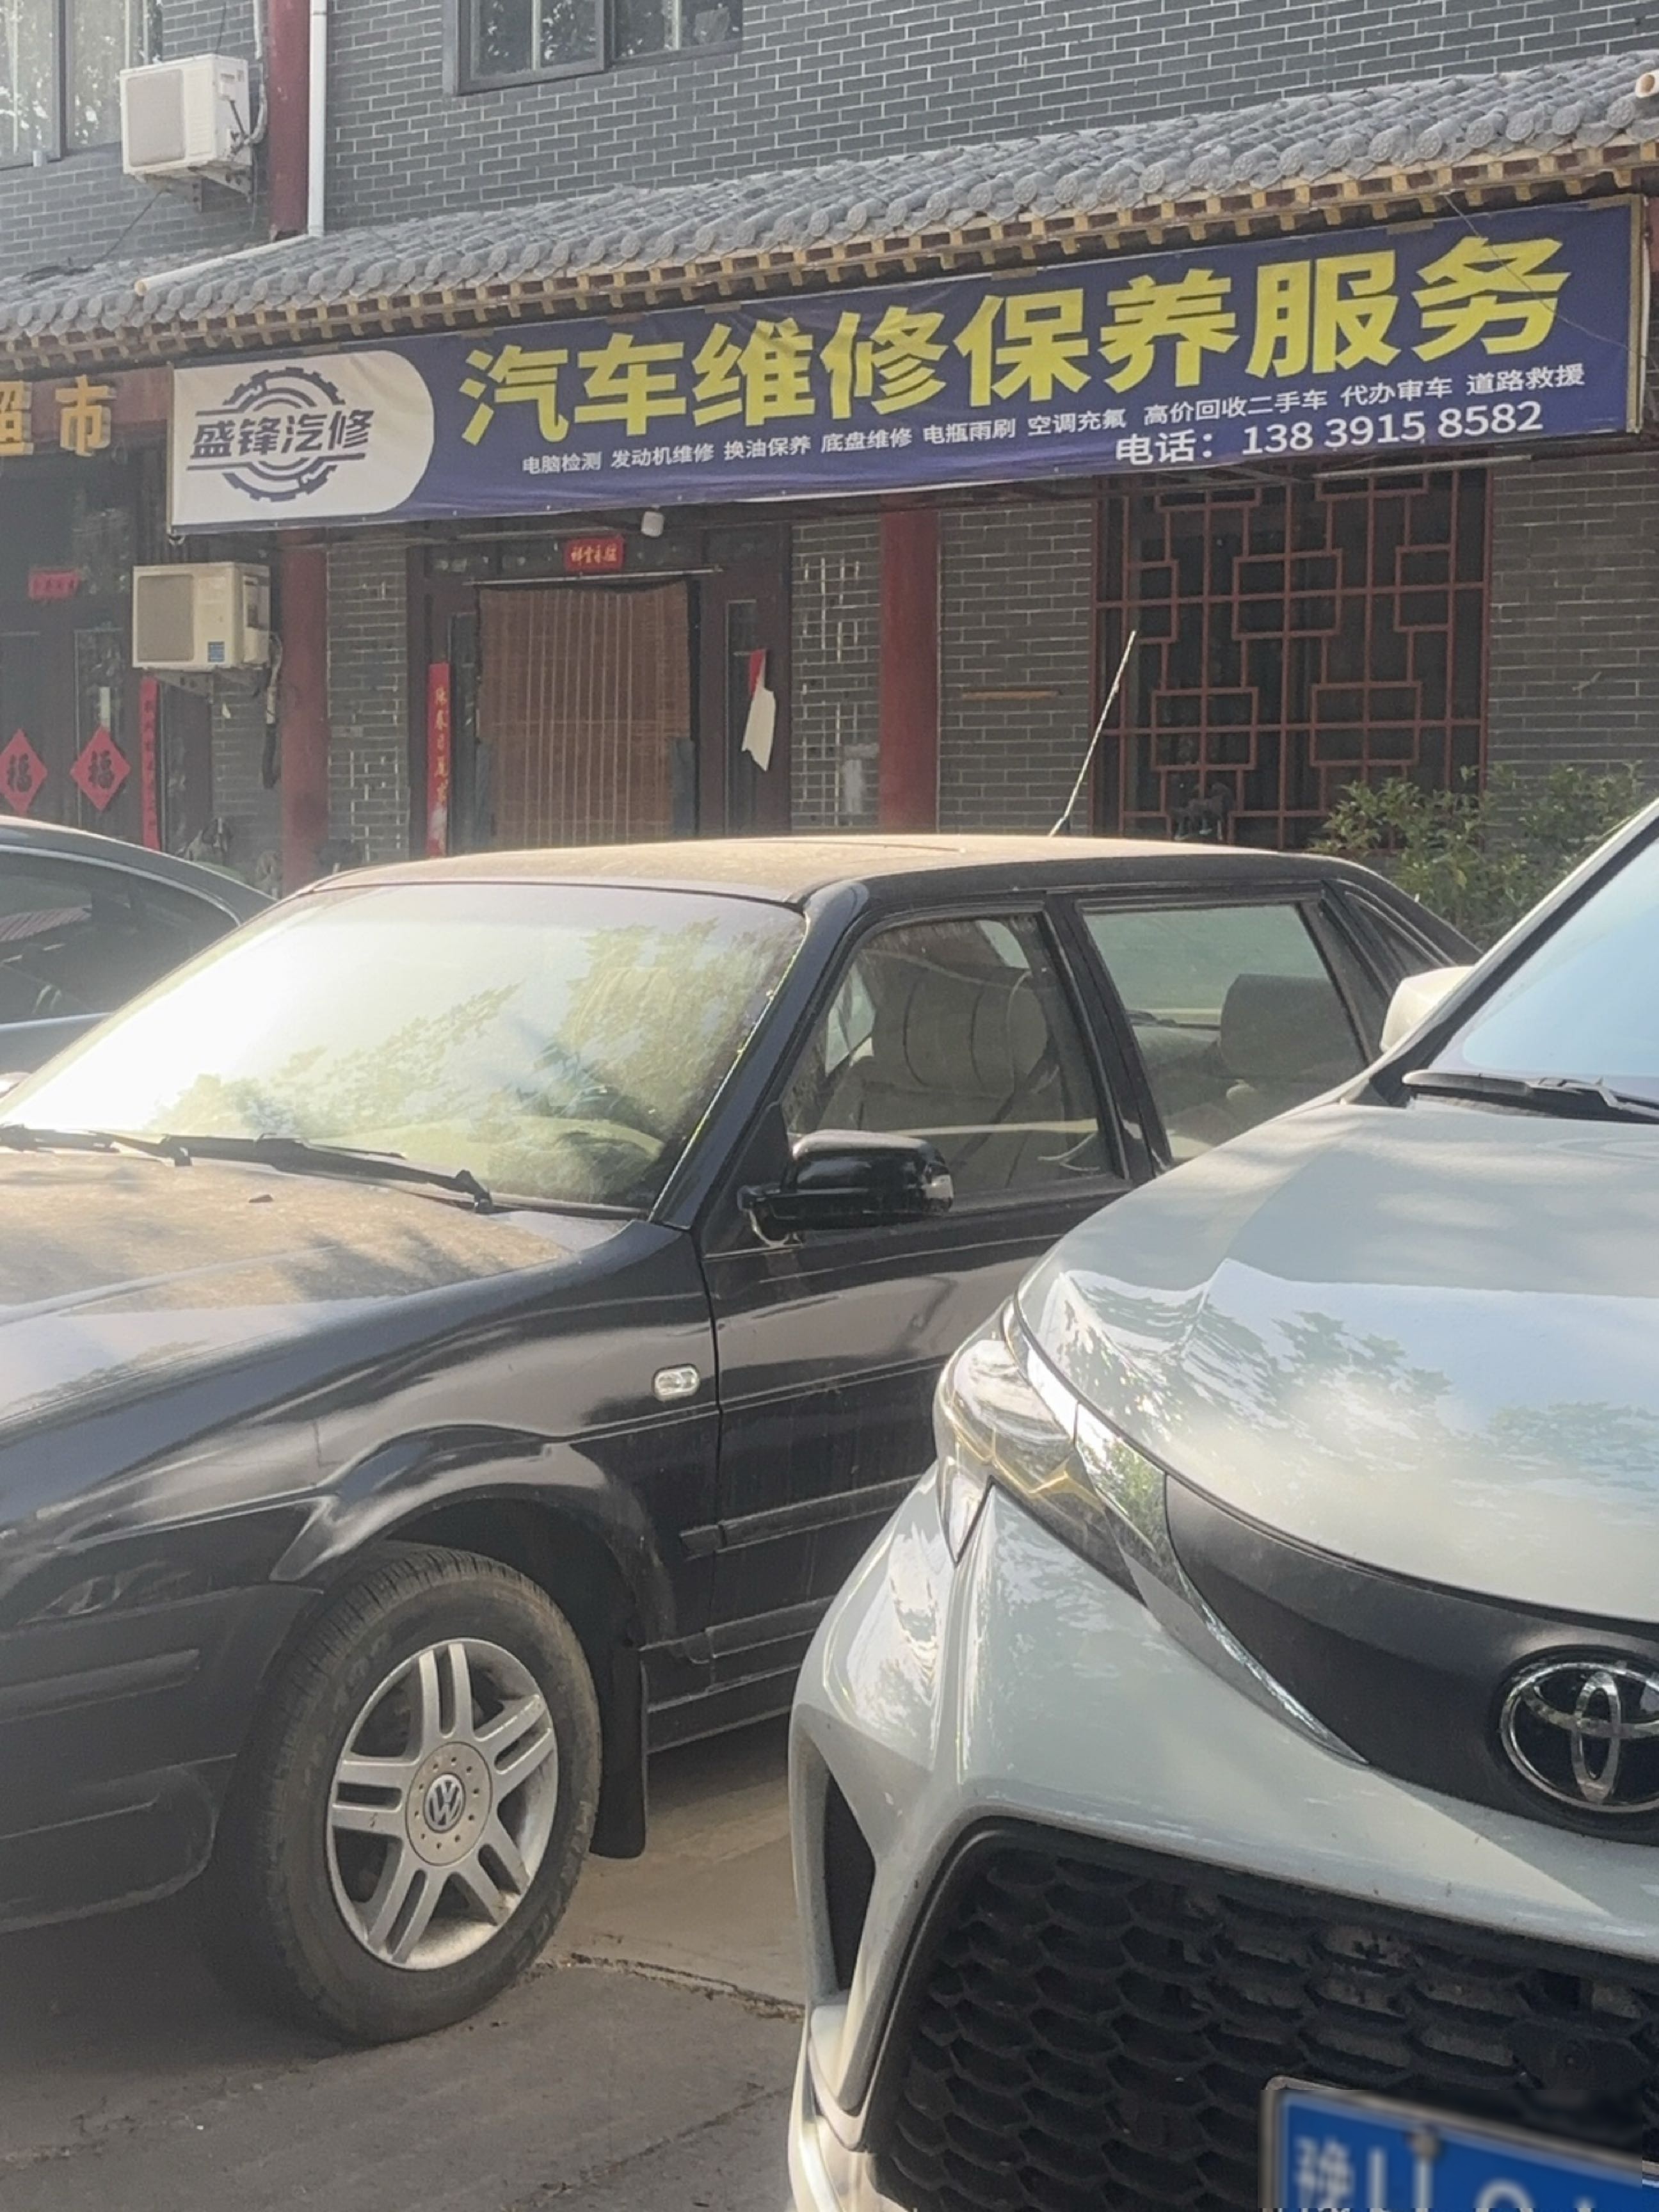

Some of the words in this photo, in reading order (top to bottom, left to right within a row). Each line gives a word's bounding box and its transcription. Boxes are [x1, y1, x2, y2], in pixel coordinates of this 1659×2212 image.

[459, 236, 1571, 445] 汽车维修保养服务
[190, 410, 374, 459] 盛锋汽修
[522, 451, 602, 474] 电脑检测
[610, 443, 715, 468] 发动机维修
[724, 435, 811, 461] 换油保养
[821, 428, 913, 453] 底盘维修
[922, 418, 1016, 444] 电瓶雨刷
[1027, 408, 1128, 437] 空调充氟
[1144, 389, 1328, 426] 高价回收二手车
[1340, 377, 1453, 407] 代办审车
[1466, 363, 1584, 396] 道路救援
[1242, 422, 1313, 456] 138
[1325, 410, 1426, 448] 3915
[1438, 401, 1544, 438] 8582
